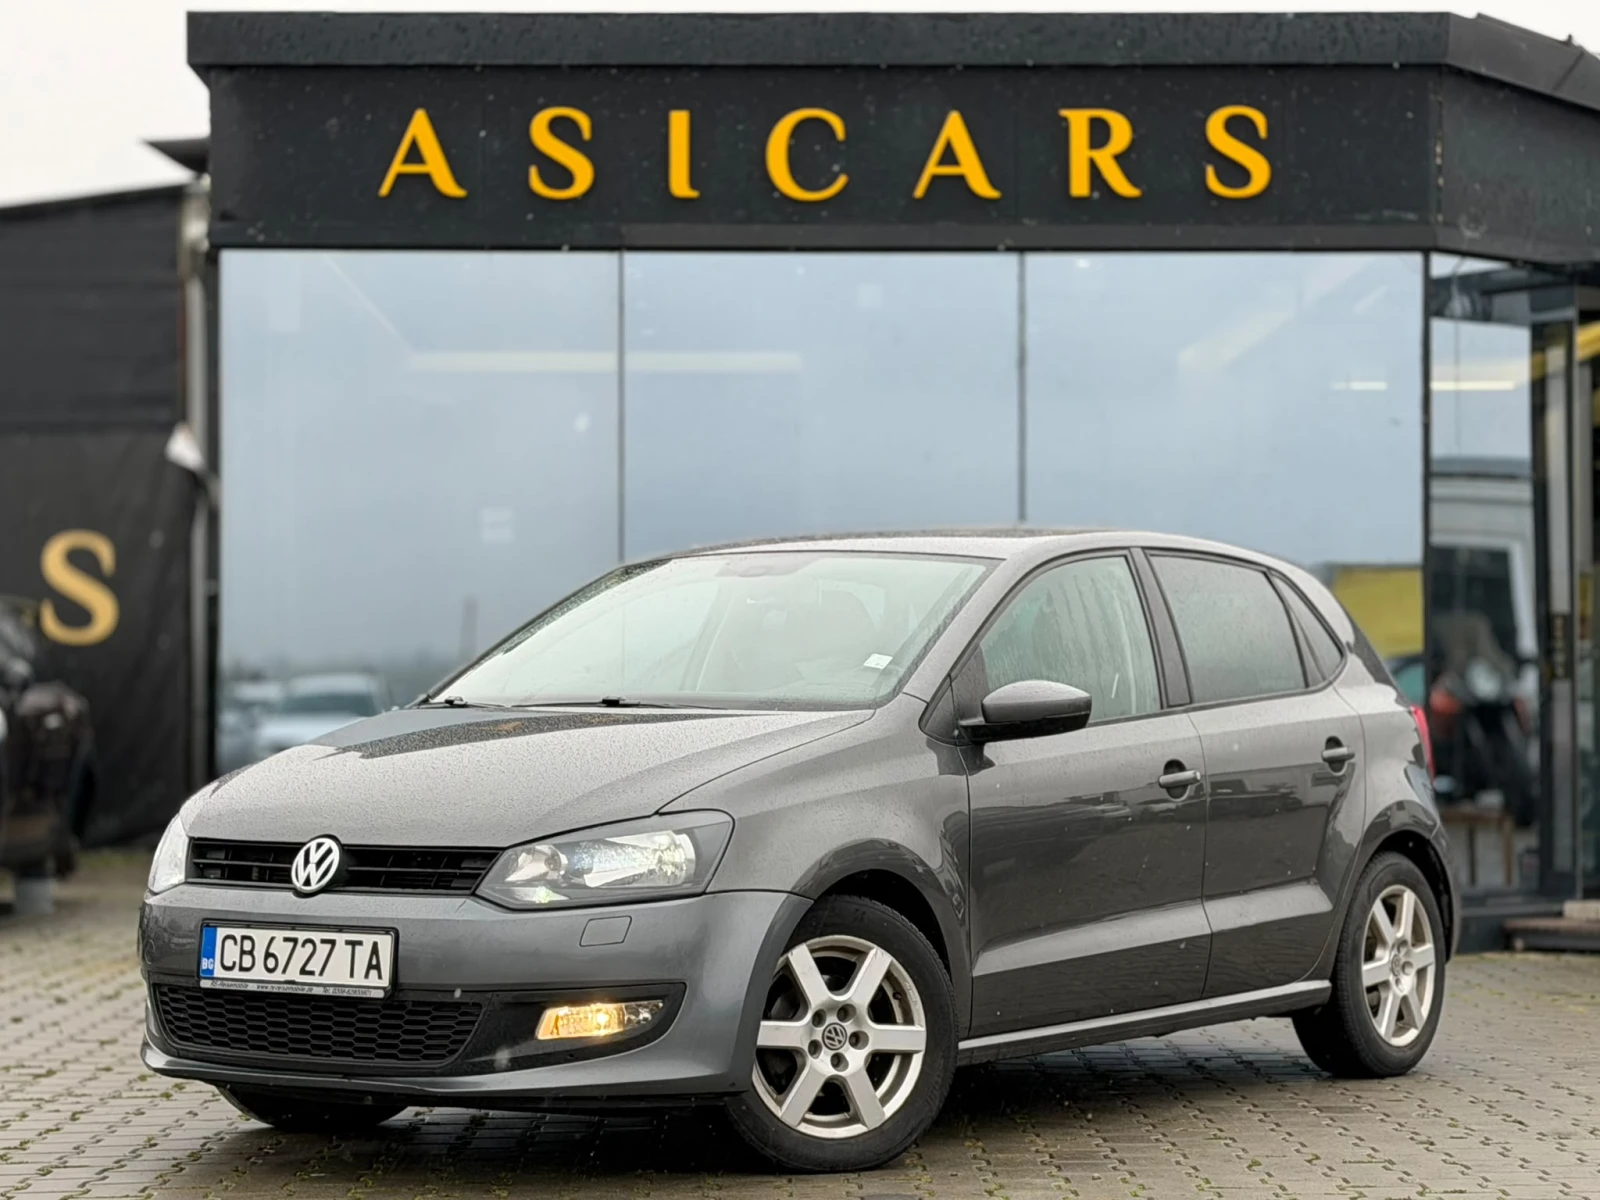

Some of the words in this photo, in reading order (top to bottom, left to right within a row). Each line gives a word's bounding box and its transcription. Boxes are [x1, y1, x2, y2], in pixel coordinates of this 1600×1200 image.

[378, 104, 1273, 202] ASICARS
[291, 838, 340, 893] VW
[202, 957, 214, 970] BG
[219, 934, 256, 973] CB
[263, 936, 337, 977] 6727
[345, 939, 383, 980] TA
